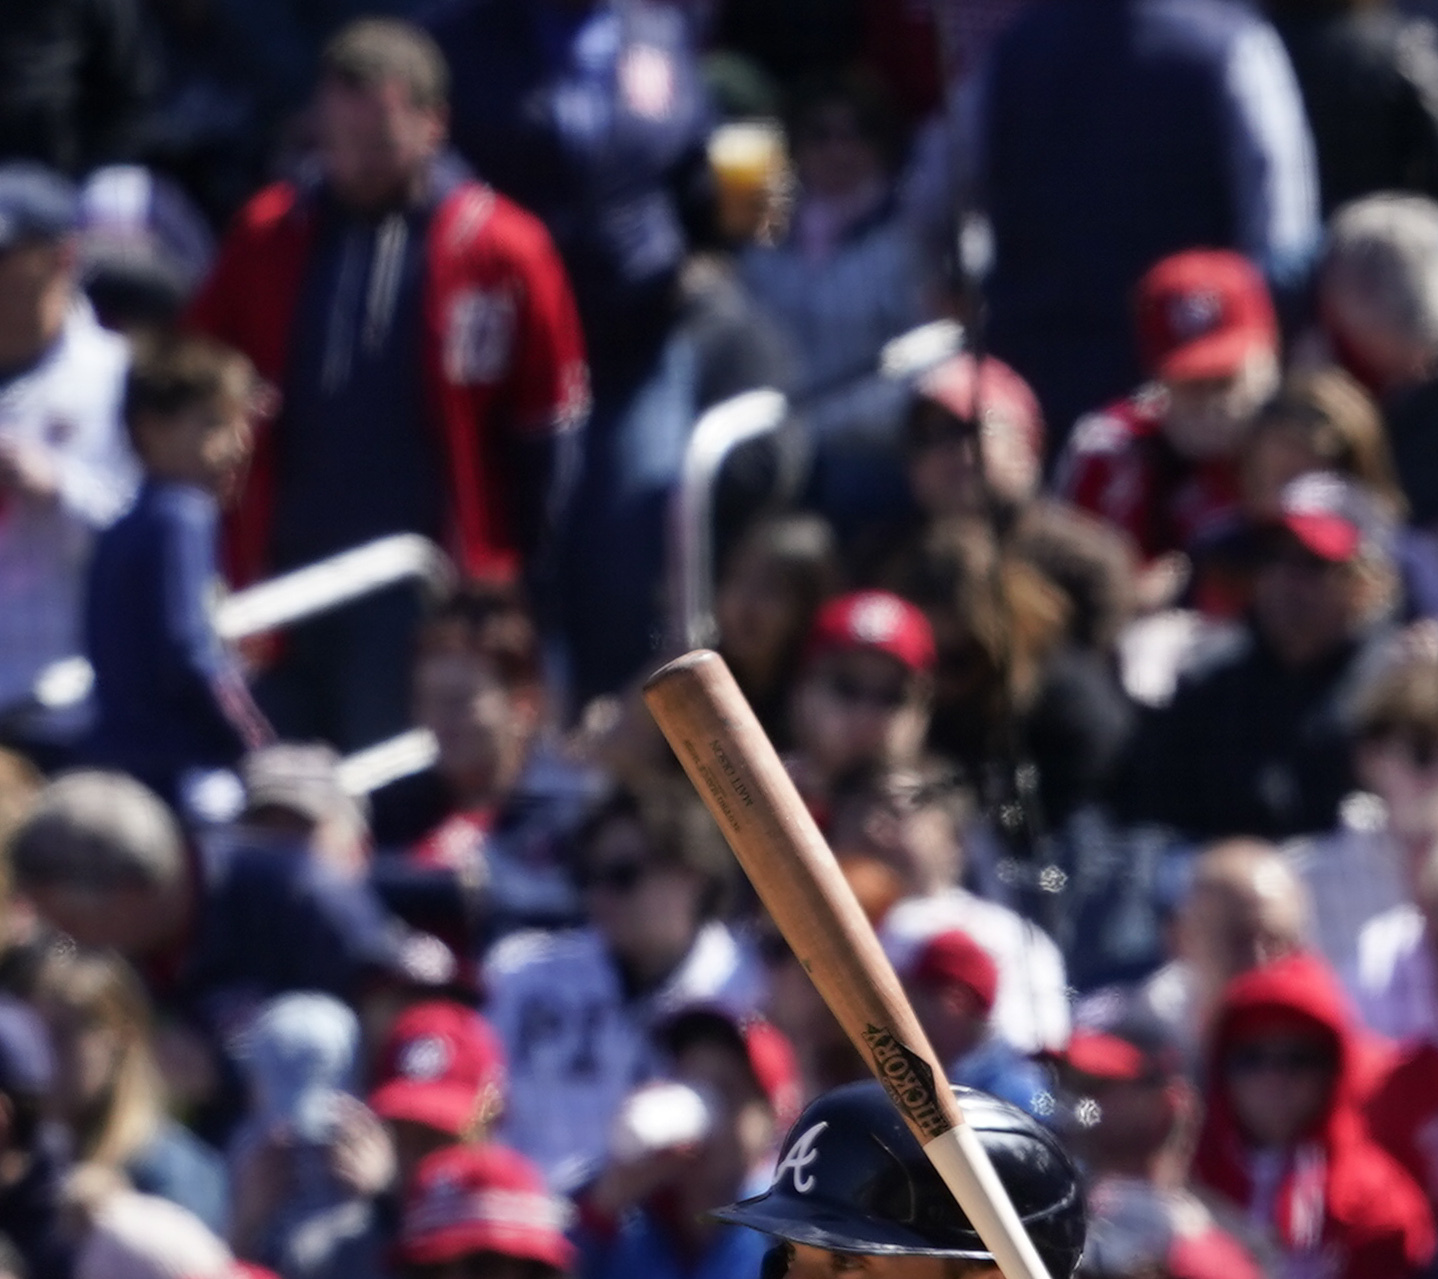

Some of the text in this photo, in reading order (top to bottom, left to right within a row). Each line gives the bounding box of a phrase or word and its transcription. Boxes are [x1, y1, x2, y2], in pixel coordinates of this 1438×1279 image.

[710, 739, 736, 777] OLSON
[731, 776, 754, 807] MATT
[861, 1024, 949, 1138] HICKORY
[772, 1120, 829, 1193] A
